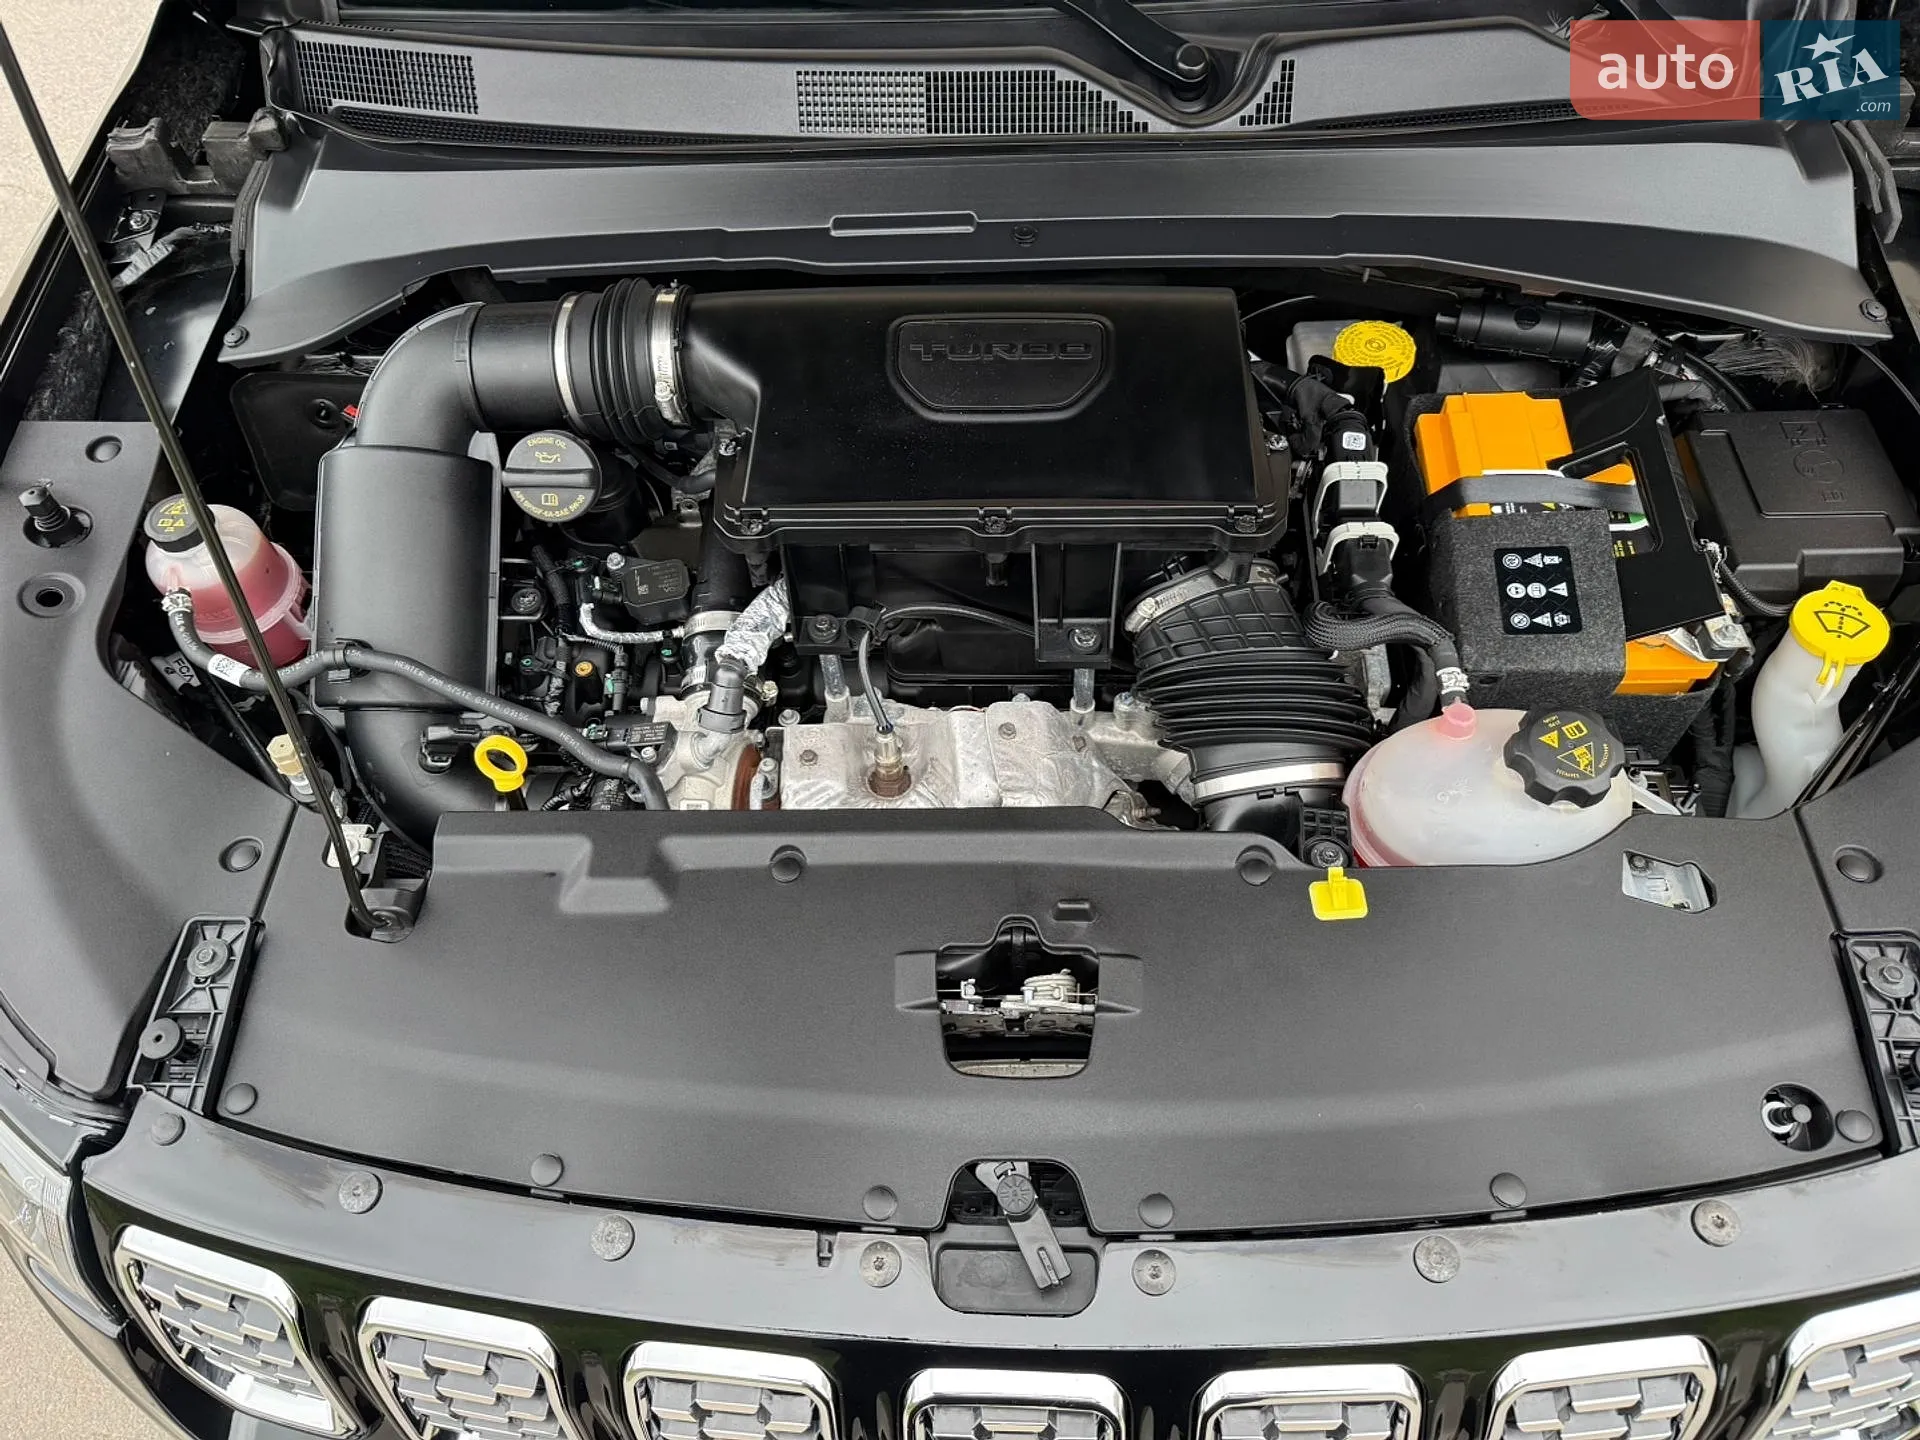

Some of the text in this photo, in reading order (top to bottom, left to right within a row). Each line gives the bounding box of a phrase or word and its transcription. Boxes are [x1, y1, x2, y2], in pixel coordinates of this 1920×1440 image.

[909, 343, 1093, 361] TURBO
[527, 437, 567, 449] ENGINE OIL
[174, 657, 194, 683] FCA
